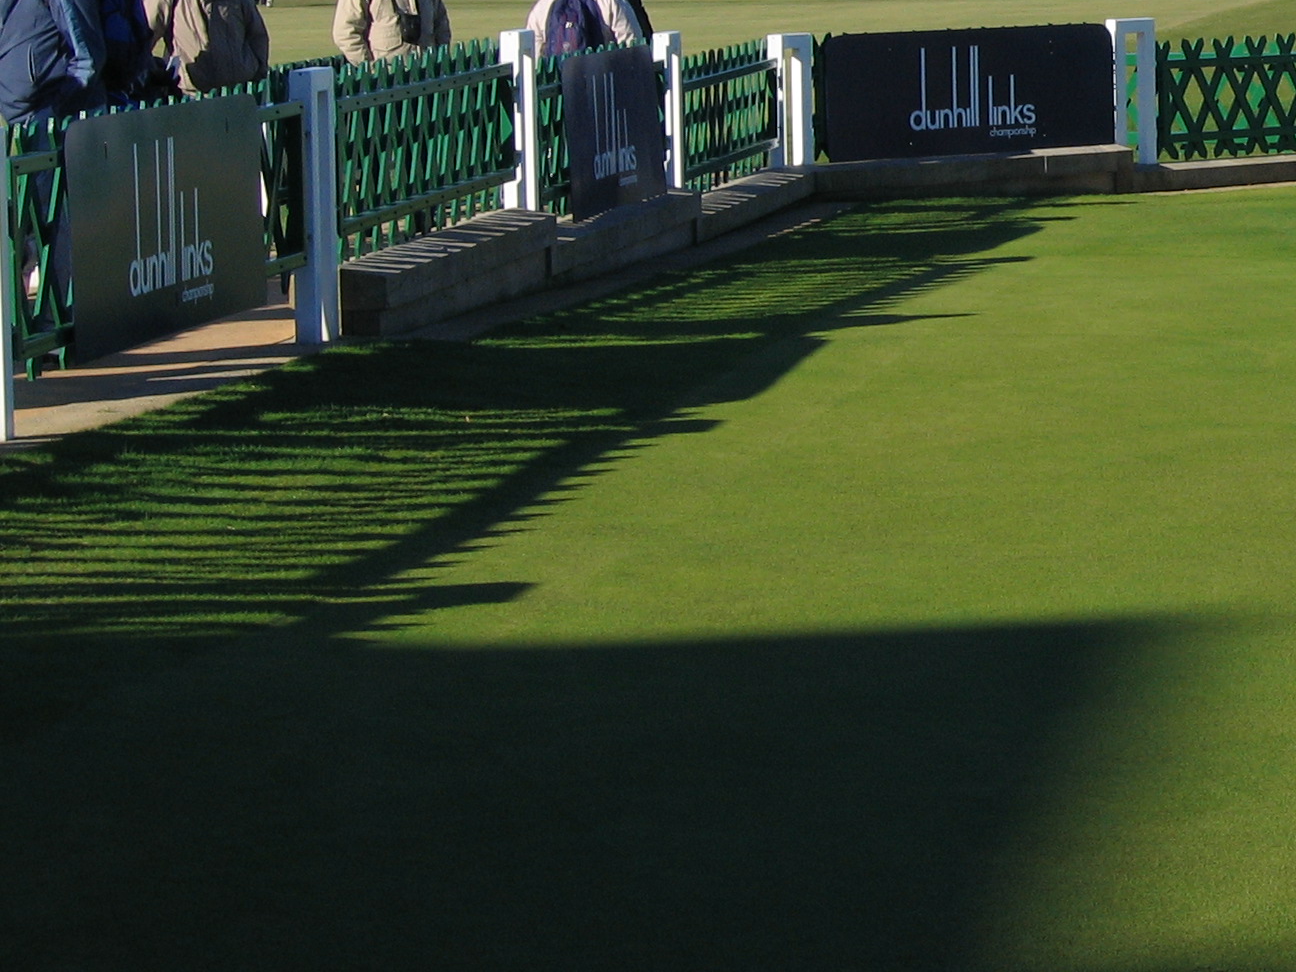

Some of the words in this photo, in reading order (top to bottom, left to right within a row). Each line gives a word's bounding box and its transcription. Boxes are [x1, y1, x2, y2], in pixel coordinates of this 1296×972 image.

[910, 45, 979, 131] dunhill
[988, 74, 1036, 126] links
[989, 125, 1037, 139] championship
[130, 136, 176, 297] dunhill
[179, 187, 213, 281] links
